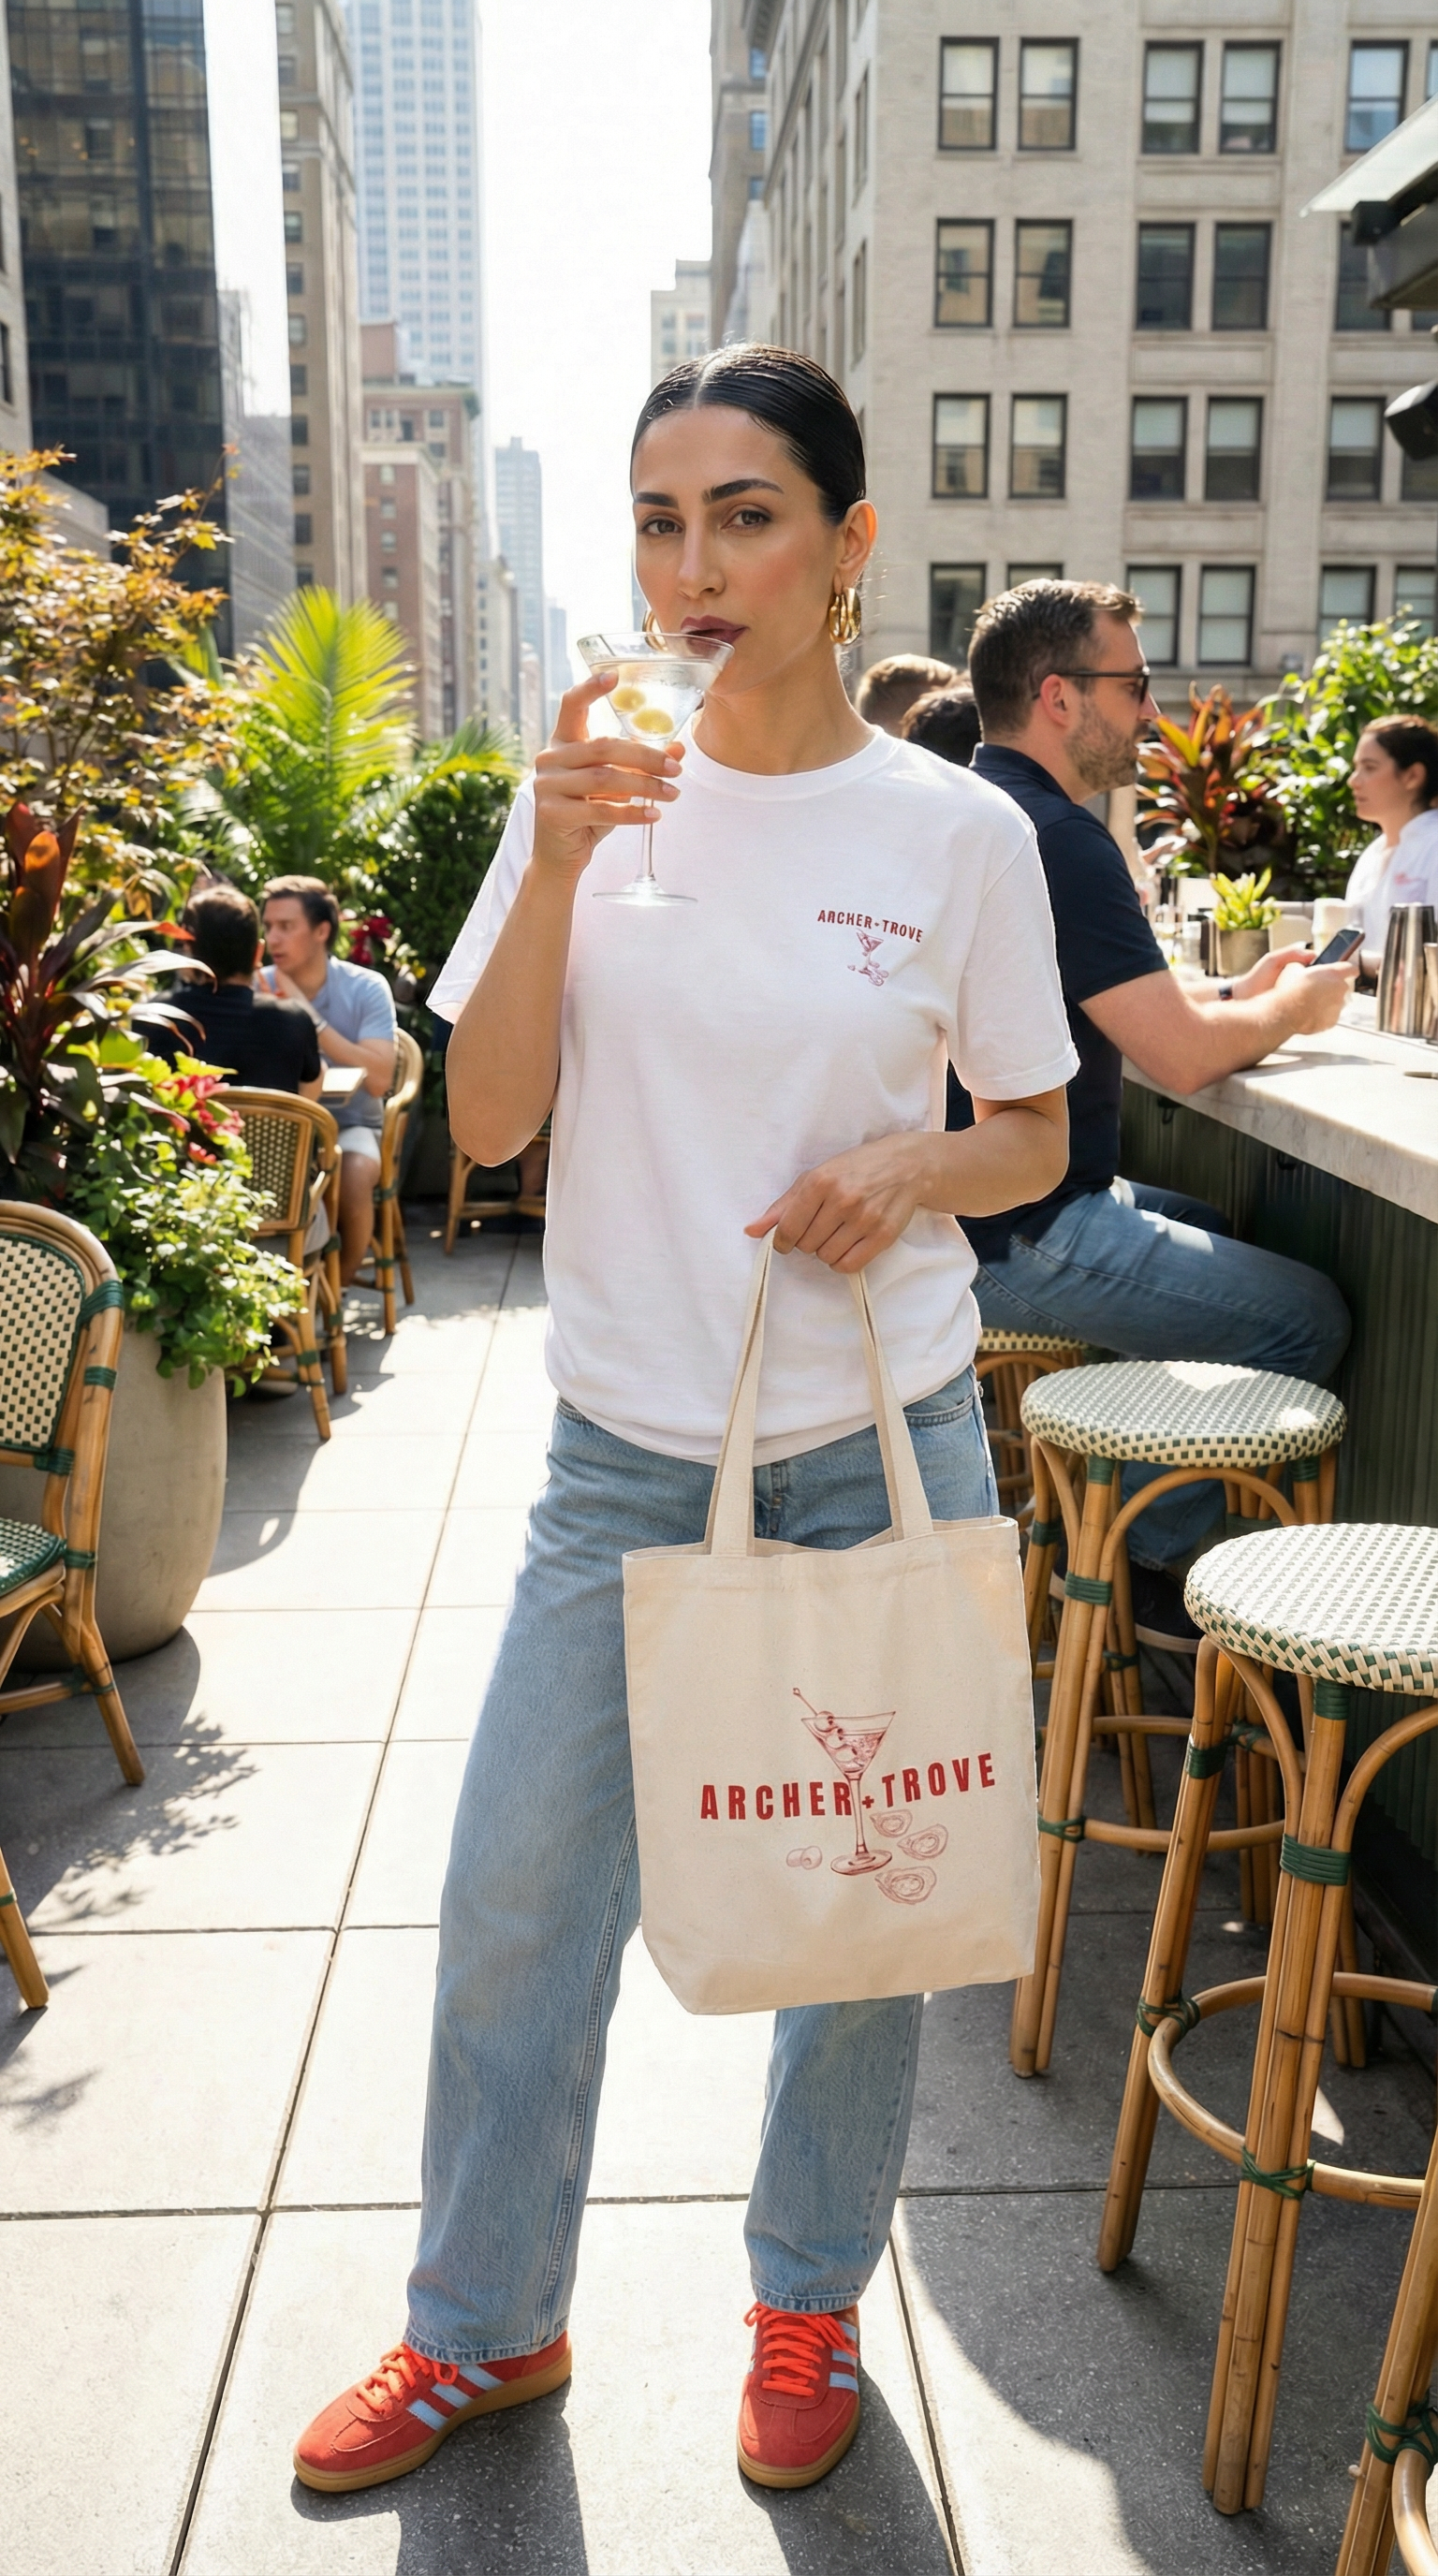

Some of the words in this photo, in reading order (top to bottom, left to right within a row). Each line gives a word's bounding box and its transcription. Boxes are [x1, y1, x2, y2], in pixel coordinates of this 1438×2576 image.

[817, 910, 873, 929] ARCHER
[883, 919, 923, 943] TROVE
[700, 1781, 852, 1820] ARCHER
[882, 1752, 995, 1808] TROVE
